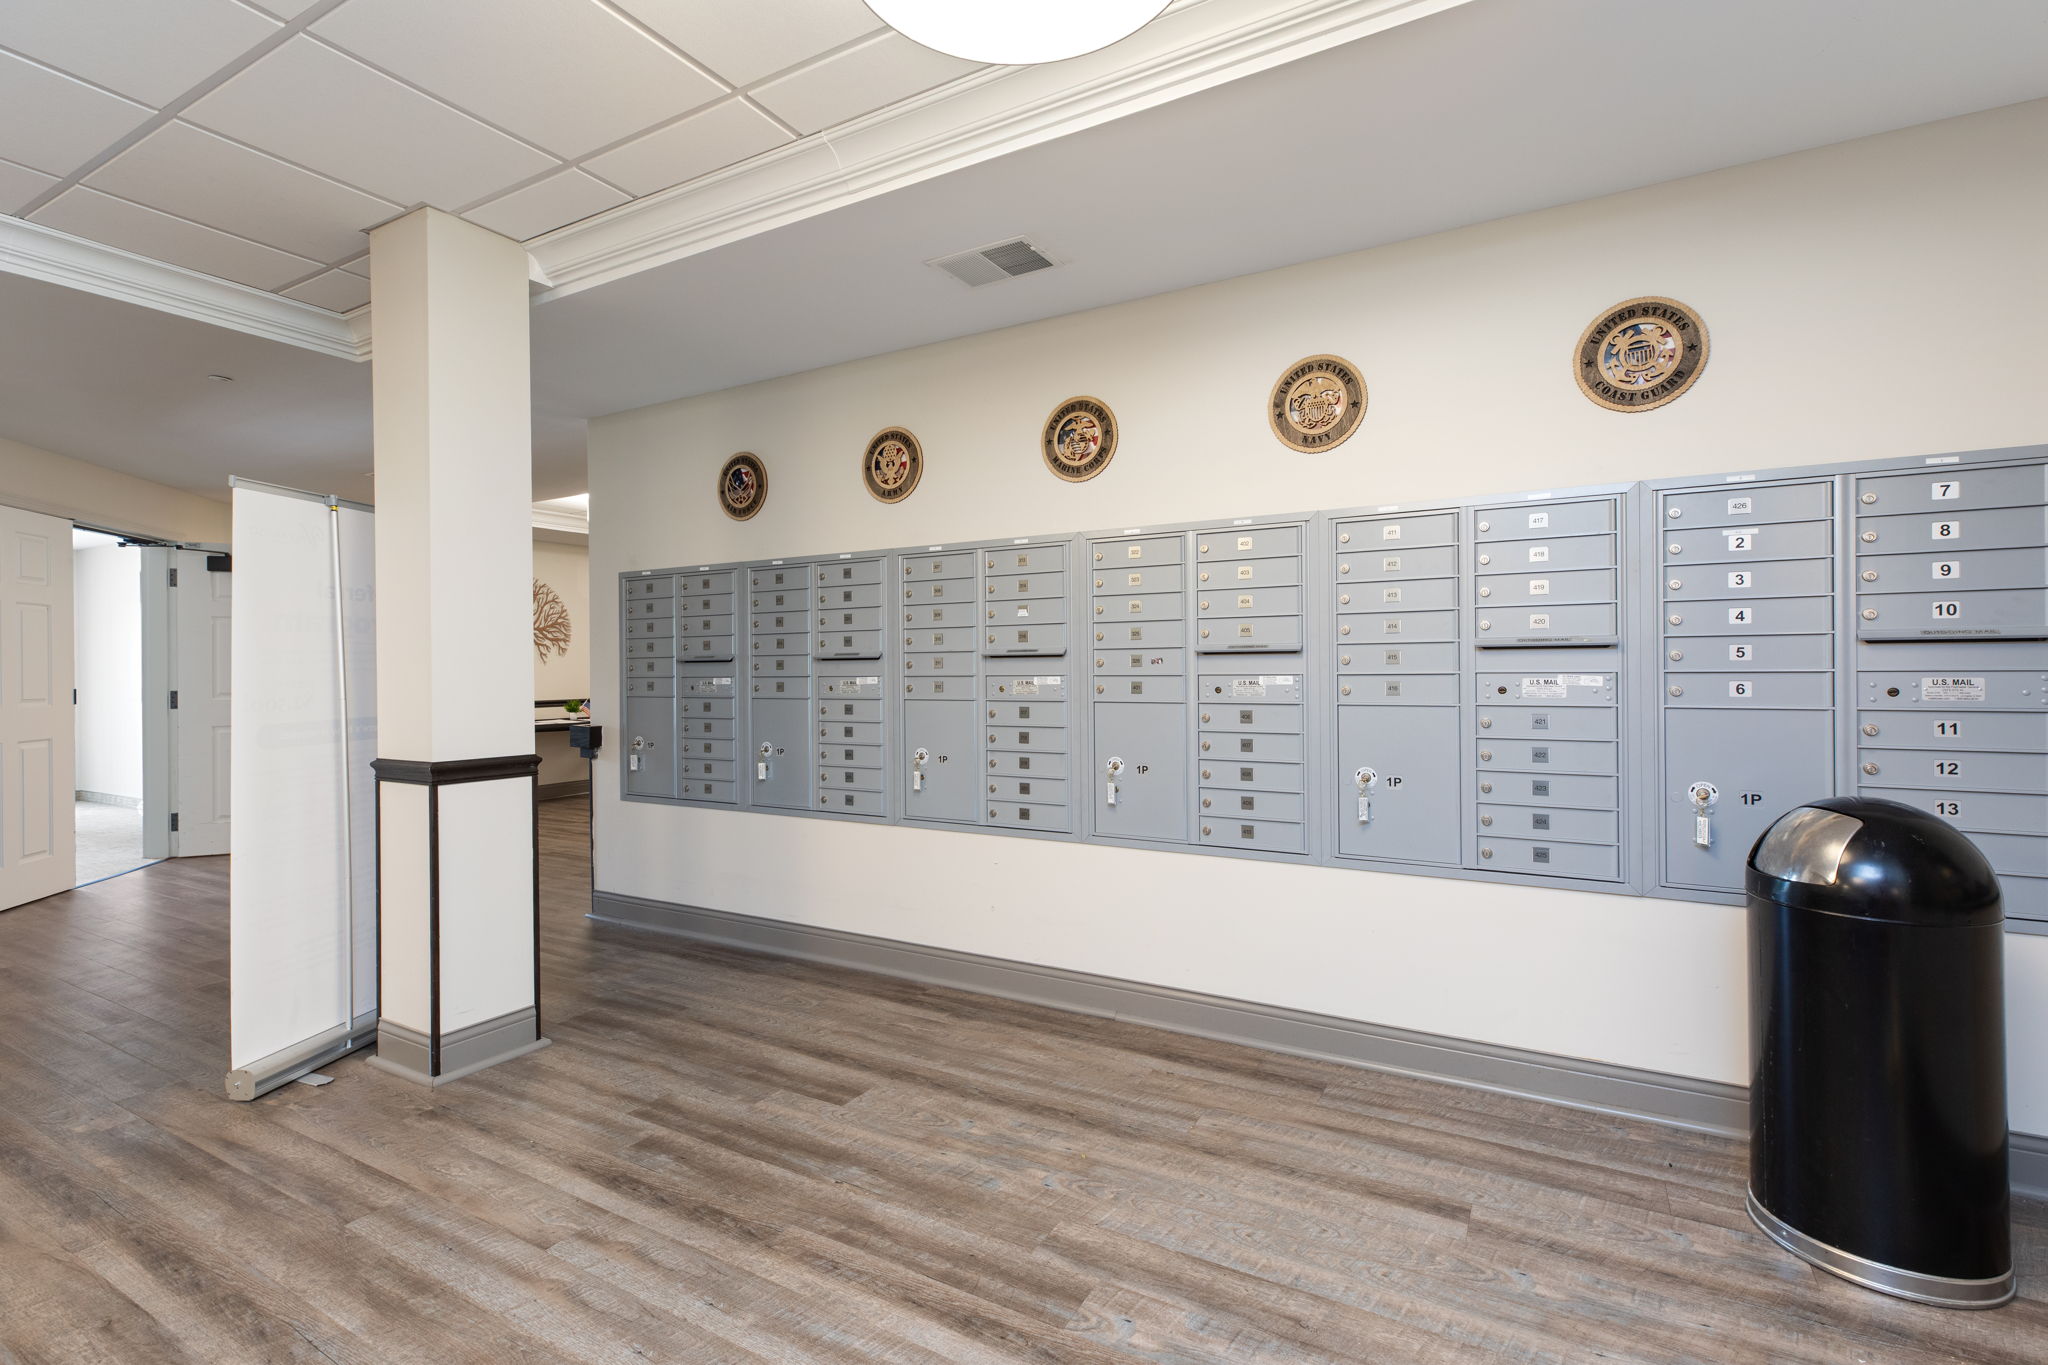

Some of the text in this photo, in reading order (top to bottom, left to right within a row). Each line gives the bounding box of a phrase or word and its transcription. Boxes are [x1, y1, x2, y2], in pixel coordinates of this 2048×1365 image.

[1590, 306, 1690, 344] UNITED STATES
[1280, 362, 1352, 394] UNITED STATES
[1595, 370, 1686, 402] COAST GUARD
[1050, 403, 1106, 430] UNITED STATES
[870, 434, 912, 454] UNITED STATES
[1301, 432, 1332, 444] NAVY
[1052, 447, 1106, 474] MARINE CORPS
[882, 486, 903, 496] ARMY
[1940, 485, 1950, 496] 7
[1940, 524, 1950, 536] 8
[1736, 538, 1744, 548] 2
[1941, 564, 1951, 576] 9
[1736, 575, 1744, 585] 3
[1736, 611, 1745, 621] 4
[1935, 604, 1957, 616] 10
[1736, 648, 1745, 658] 5
[1736, 684, 1745, 694] 6
[1938, 723, 1958, 734] 11
[1936, 763, 1958, 775] 12
[1387, 778, 1402, 787] 1P
[1741, 794, 1762, 805] 1P
[1937, 803, 1958, 815] 13
